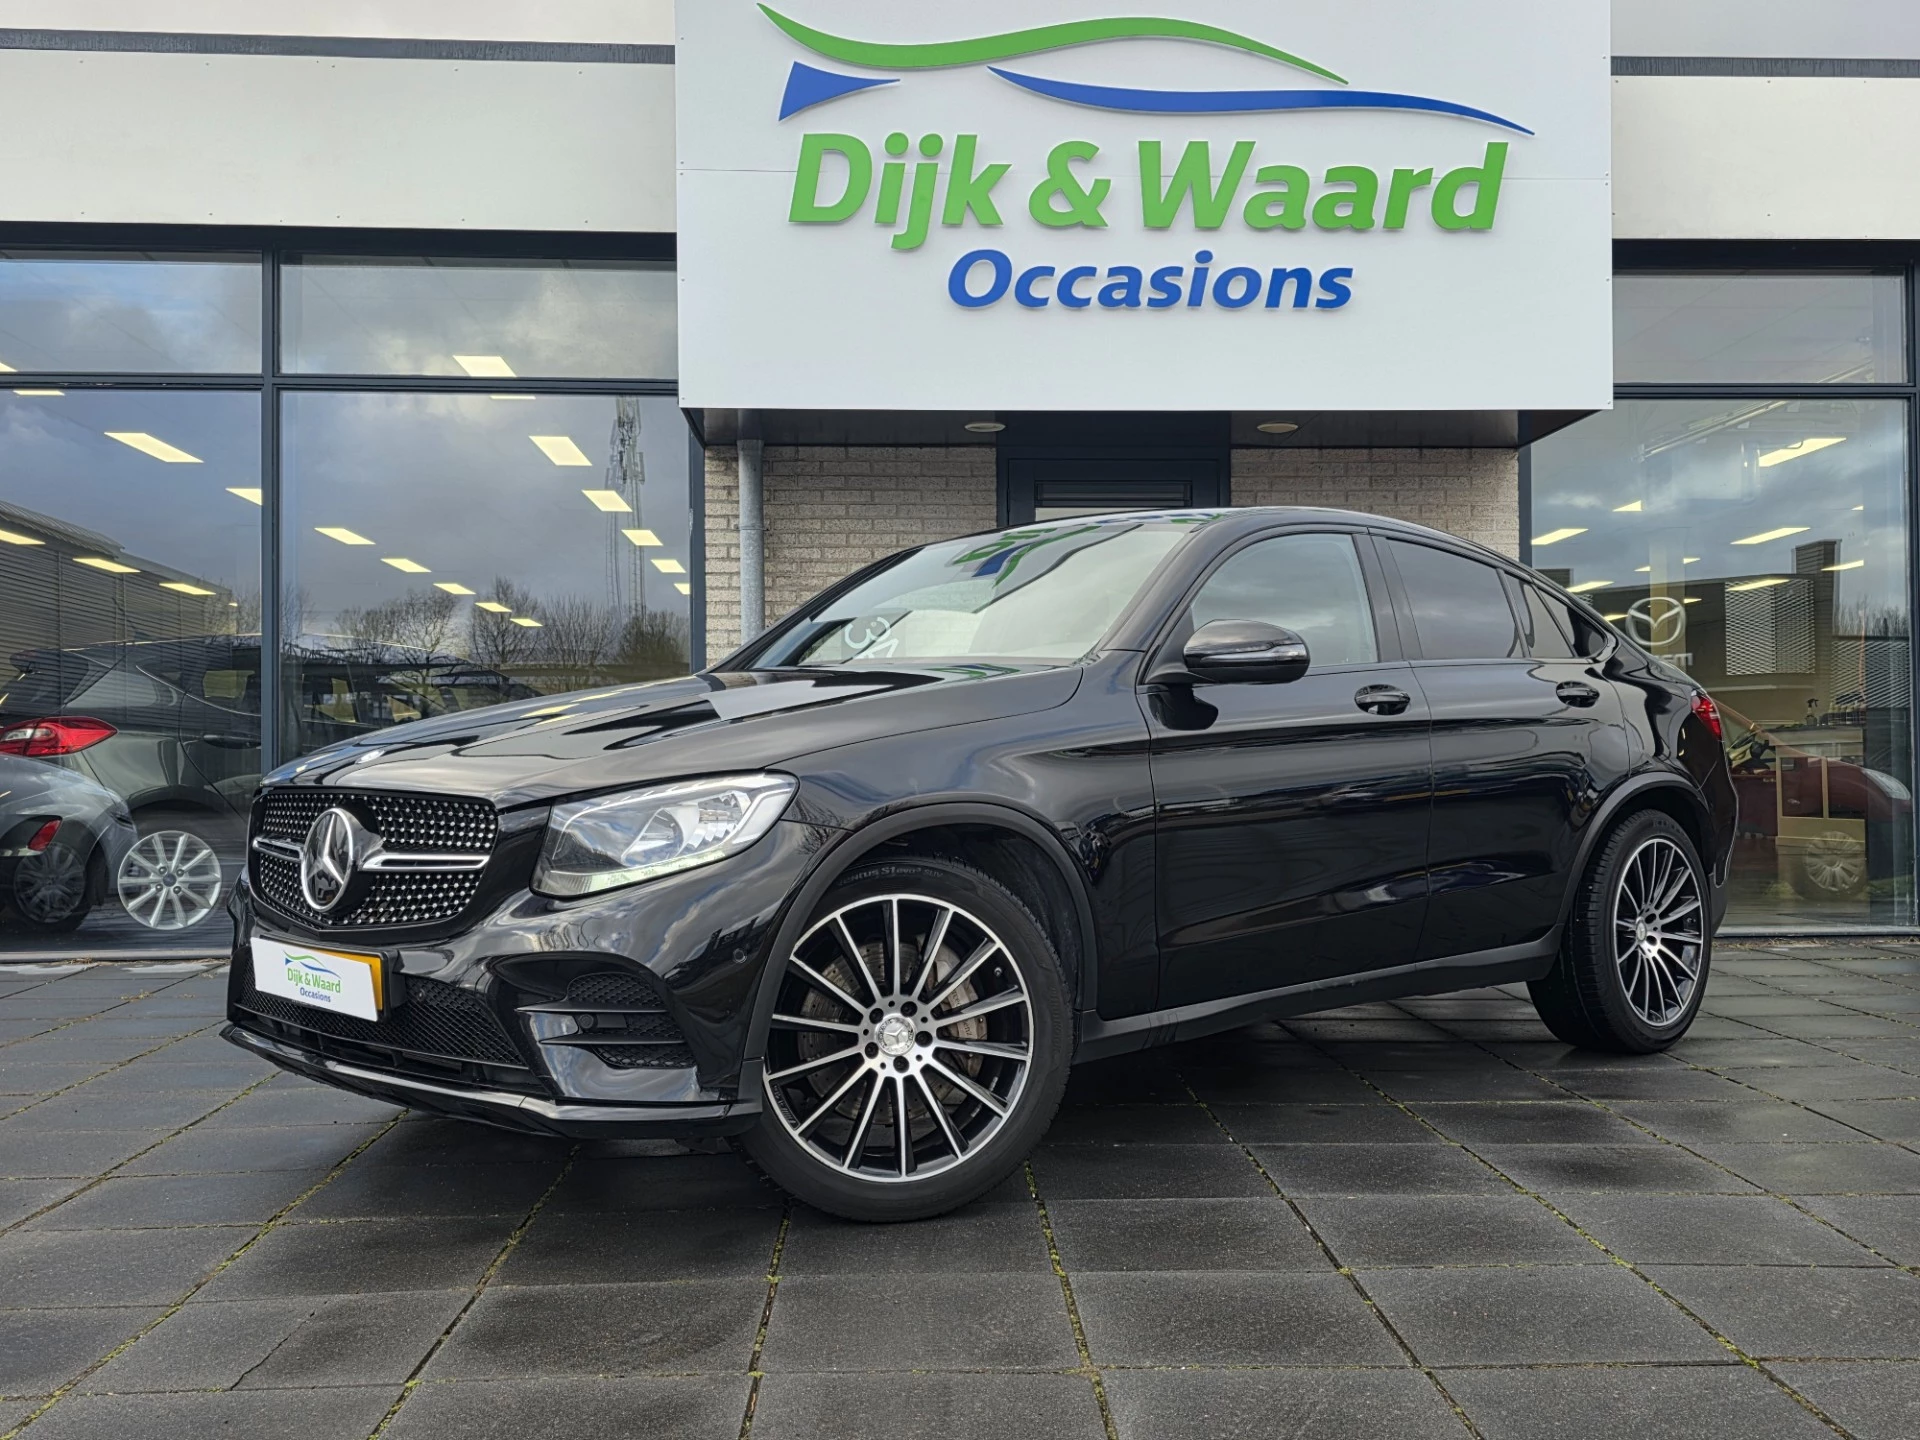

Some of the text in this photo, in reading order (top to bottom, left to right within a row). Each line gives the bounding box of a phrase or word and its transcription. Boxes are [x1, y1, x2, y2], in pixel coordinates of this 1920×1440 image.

[789, 132, 1508, 249] Dijk & Waard
[948, 249, 1353, 309] Occasions
[287, 968, 341, 993] Dijk & Waard
[300, 987, 331, 1002] Occasions
